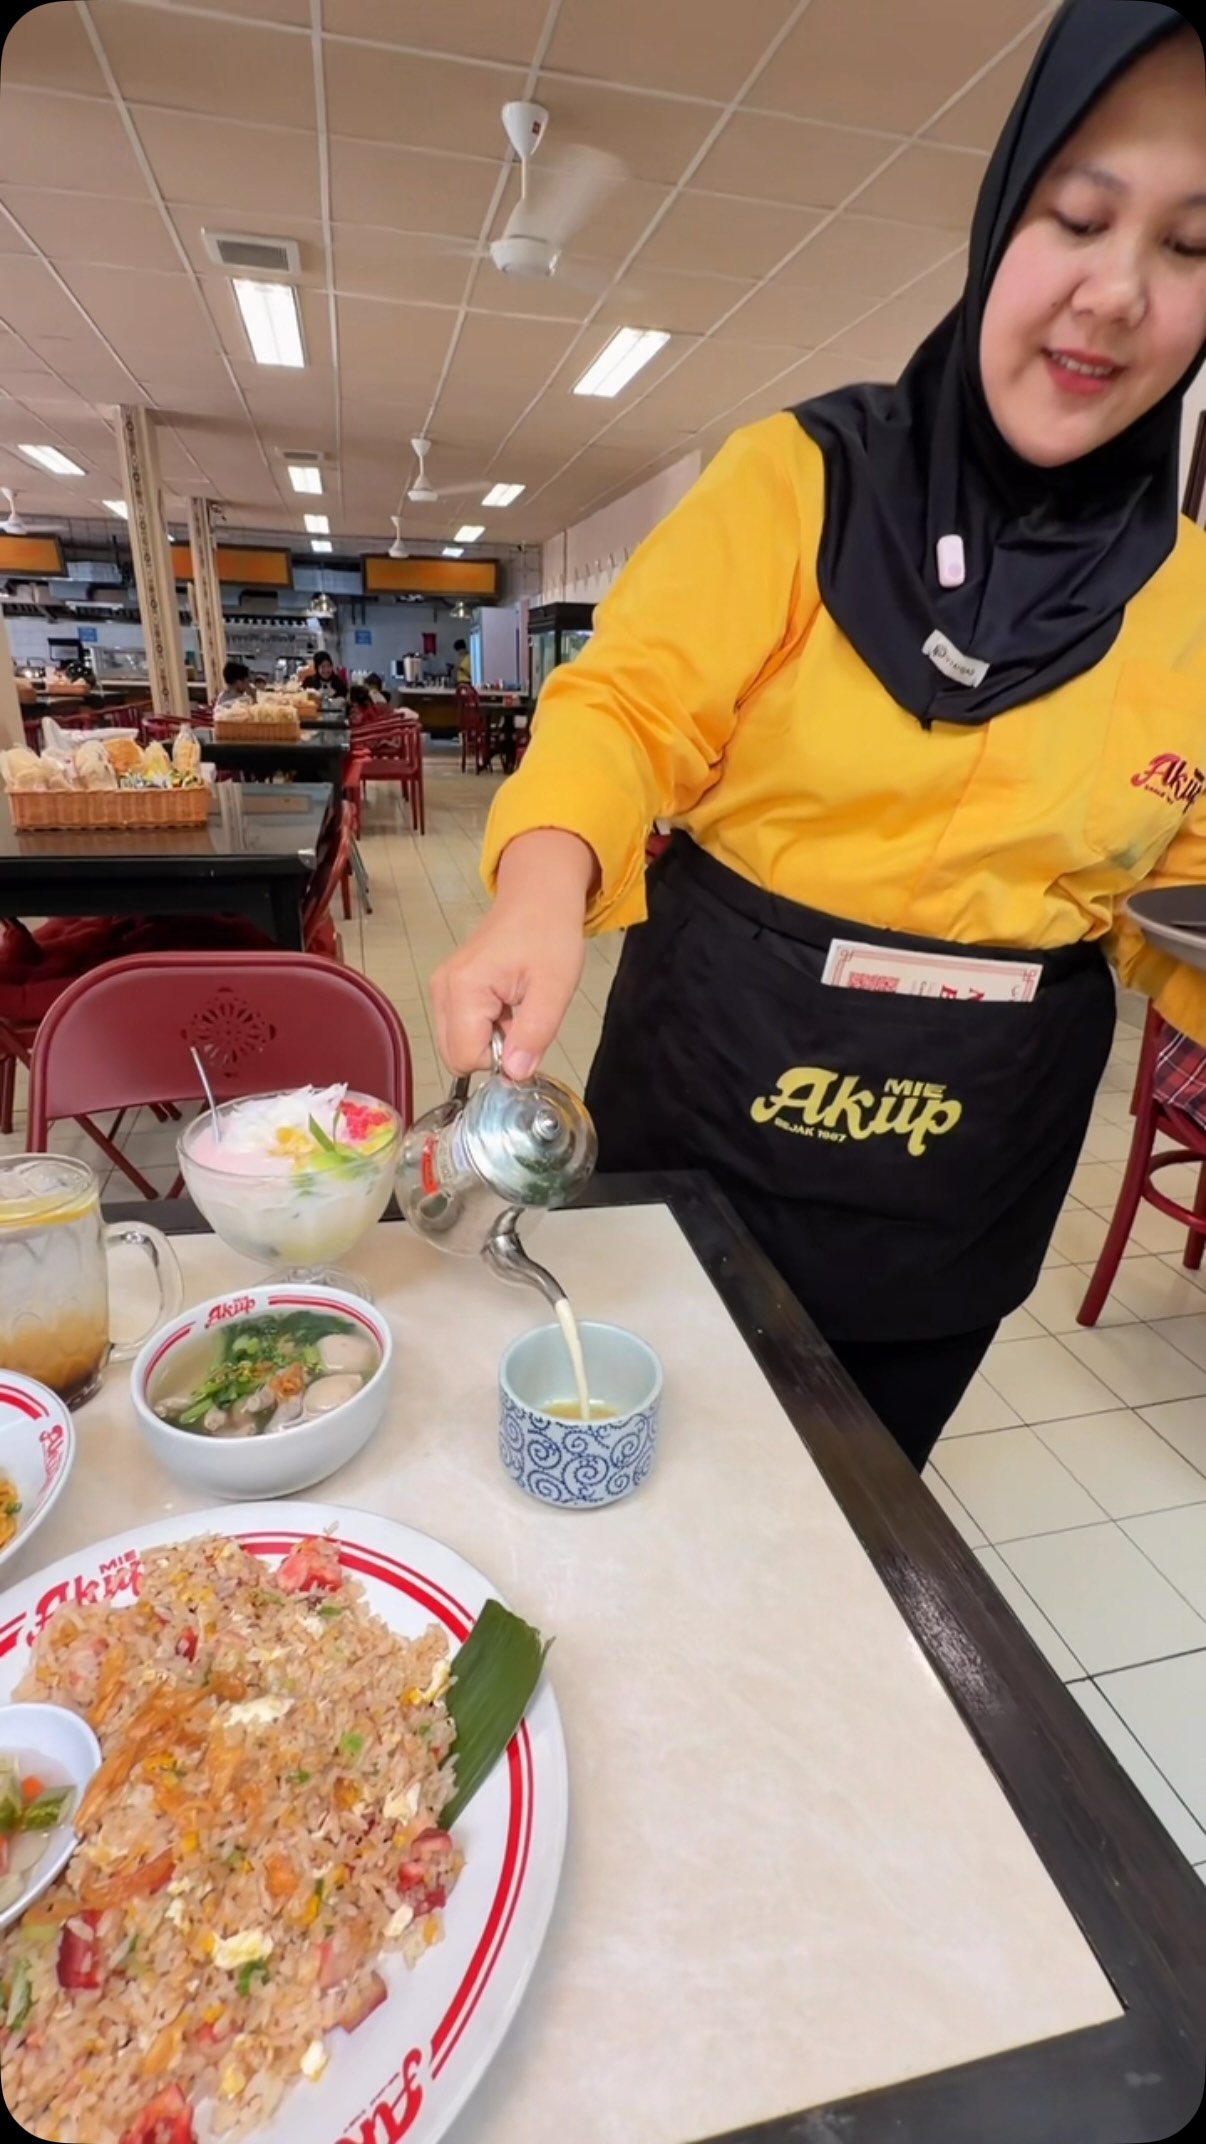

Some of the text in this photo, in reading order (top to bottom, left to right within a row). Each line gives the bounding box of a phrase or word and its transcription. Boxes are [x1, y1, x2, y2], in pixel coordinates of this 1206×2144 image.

[884, 1078, 947, 1099] MIE
[750, 1066, 962, 1157] Akup
[99, 1550, 136, 1574] MIE
